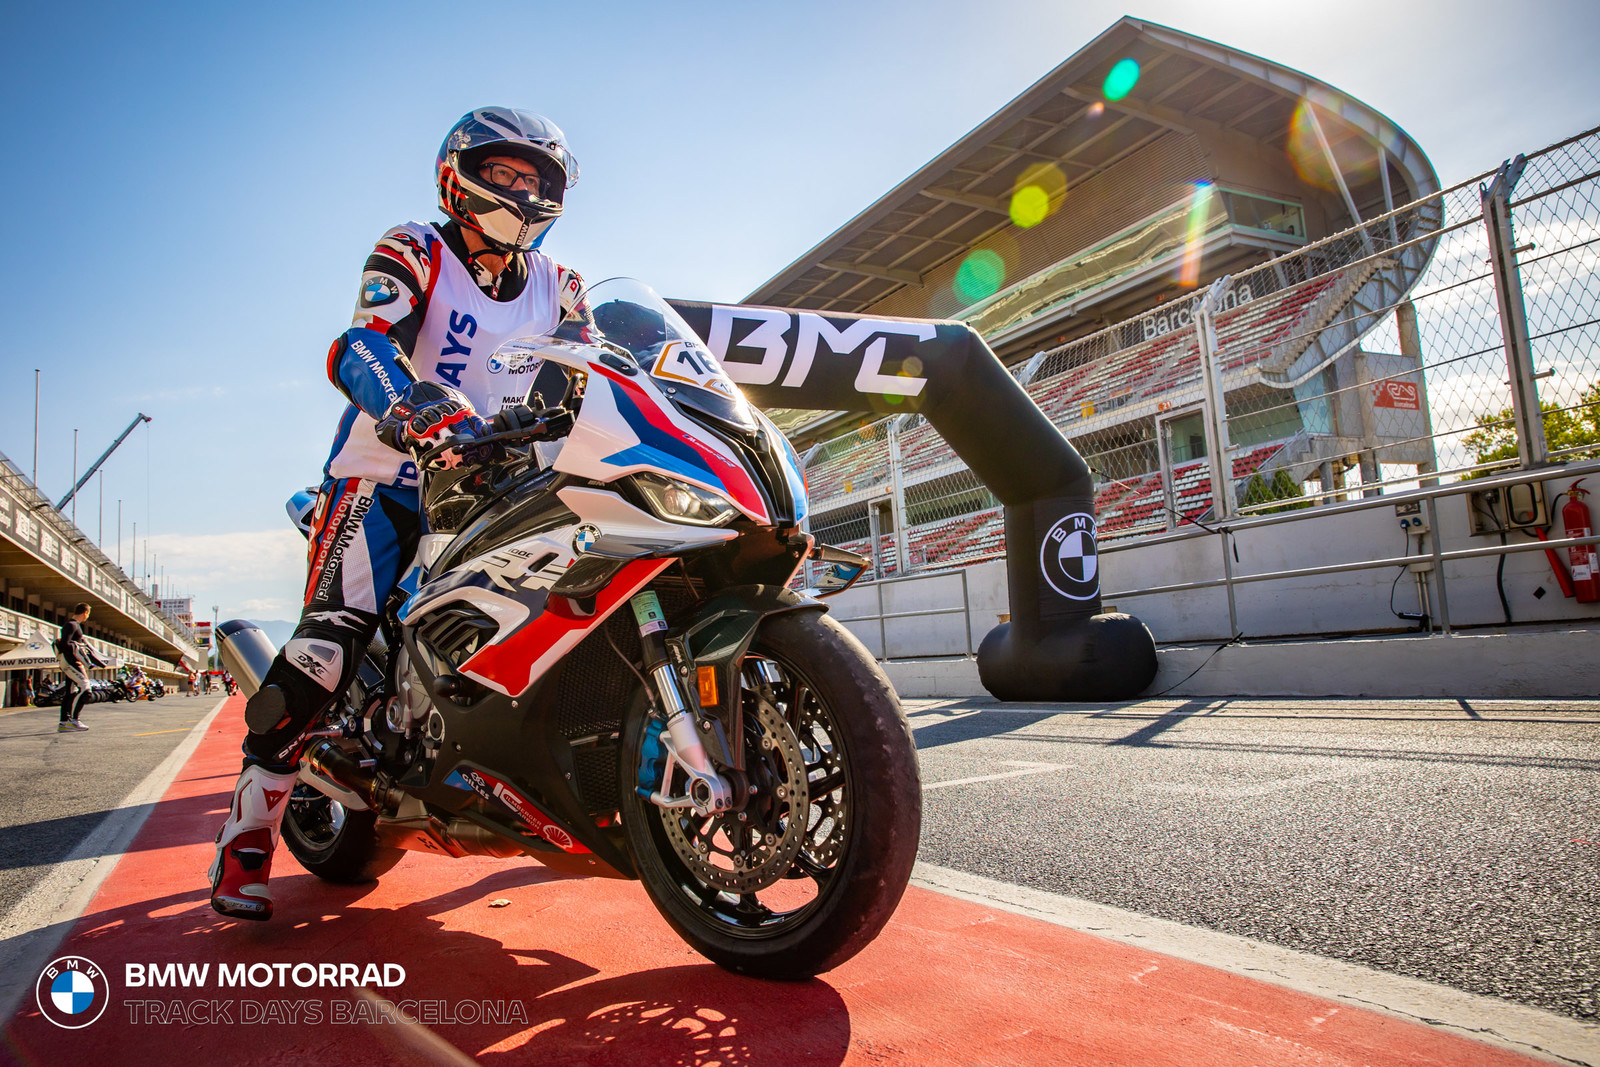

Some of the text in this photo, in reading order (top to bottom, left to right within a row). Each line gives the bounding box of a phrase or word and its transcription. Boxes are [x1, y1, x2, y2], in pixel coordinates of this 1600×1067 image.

[516, 223, 529, 246] BMW
[366, 276, 399, 295] BMW
[350, 339, 399, 403] BMW Motorra
[435, 309, 478, 388] AYS
[707, 305, 937, 397] BMC
[315, 491, 357, 571] Motorsport
[315, 495, 375, 602] BMW Motorrad
[574, 524, 601, 538] BMW
[461, 773, 490, 800] GILLES
